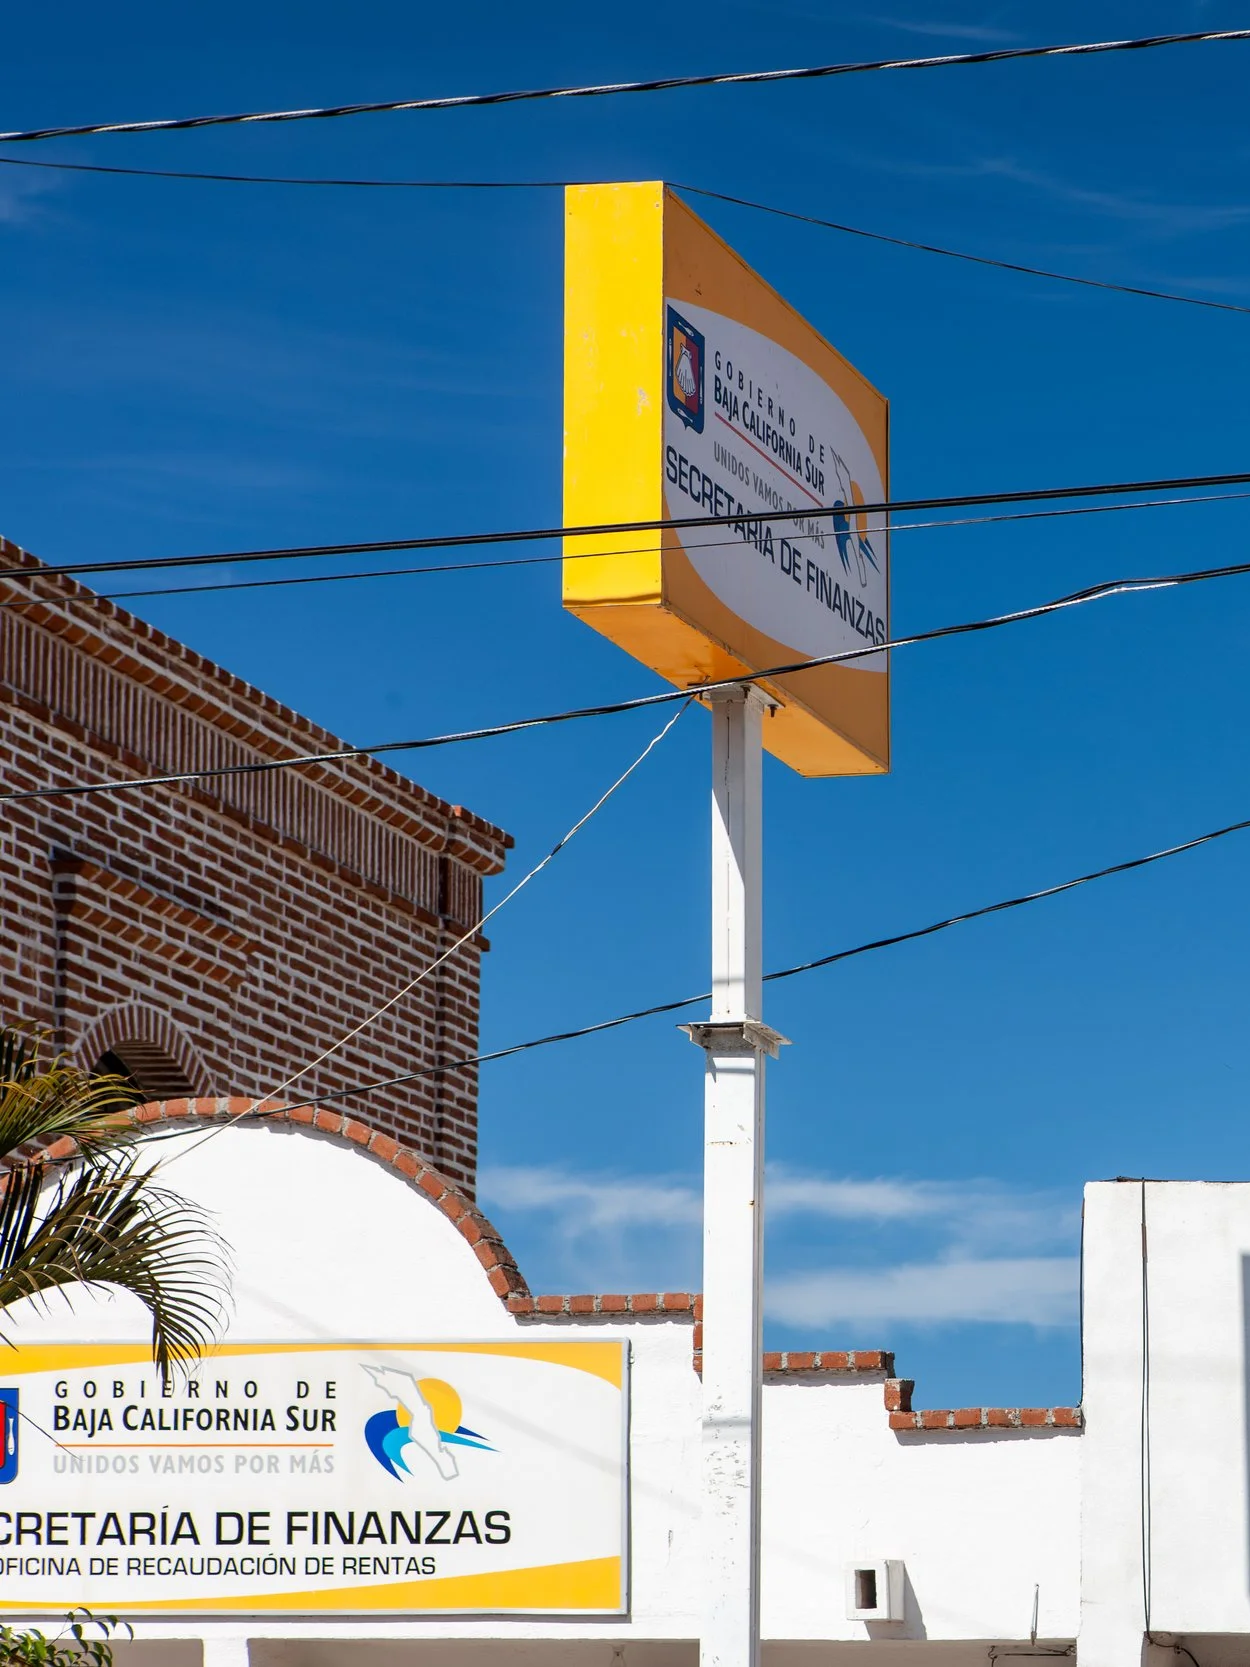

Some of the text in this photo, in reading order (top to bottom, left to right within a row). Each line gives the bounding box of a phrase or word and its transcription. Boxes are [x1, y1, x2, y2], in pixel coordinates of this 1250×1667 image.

[714, 350, 825, 463] GOBIERNO DE
[714, 374, 825, 496] BAJA CALIFORNIA SUR
[714, 441, 750, 486] UNIDOS
[753, 472, 784, 513] VAMOS
[781, 538, 802, 586] DE
[806, 558, 886, 648] FINANZAS
[54, 1380, 337, 1400] GOBIERNO DE
[53, 1404, 337, 1437] BAJA CALIFORNIA SUR
[53, 1449, 335, 1474] UNIDOS VAMOS POR MÁS
[215, 1511, 271, 1546] DE
[286, 1510, 511, 1545] FINANZAS
[0, 1553, 436, 1576] FICINA DE RECAUDACIÓN DE RENTAS
